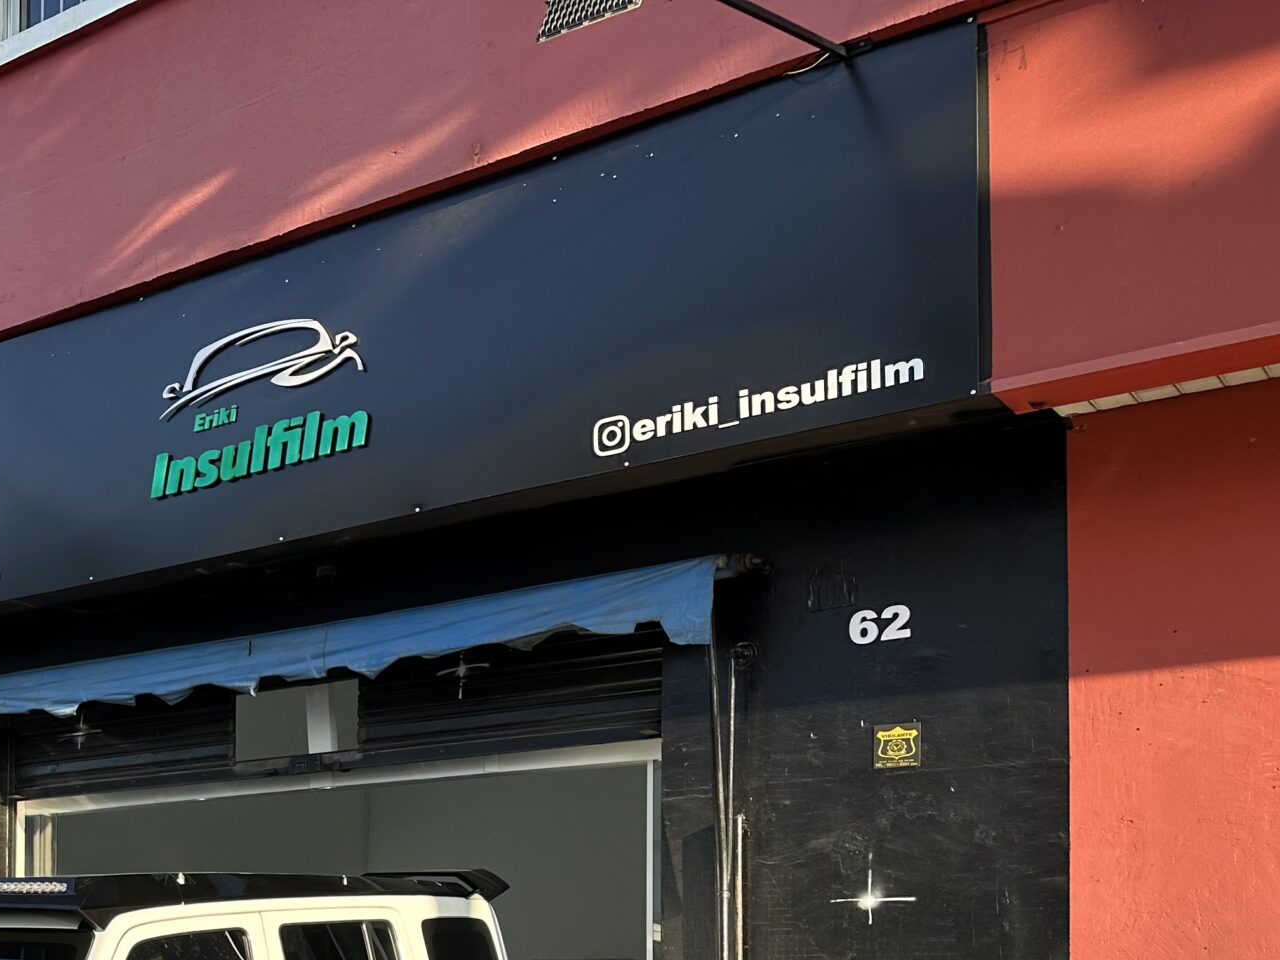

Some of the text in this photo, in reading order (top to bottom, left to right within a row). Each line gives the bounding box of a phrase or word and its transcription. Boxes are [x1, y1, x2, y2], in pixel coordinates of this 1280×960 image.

[193, 404, 238, 432] Eriki
[632, 357, 925, 443] eriki_insulfilm
[150, 410, 370, 499] Insulfilm
[848, 604, 912, 645] 62
